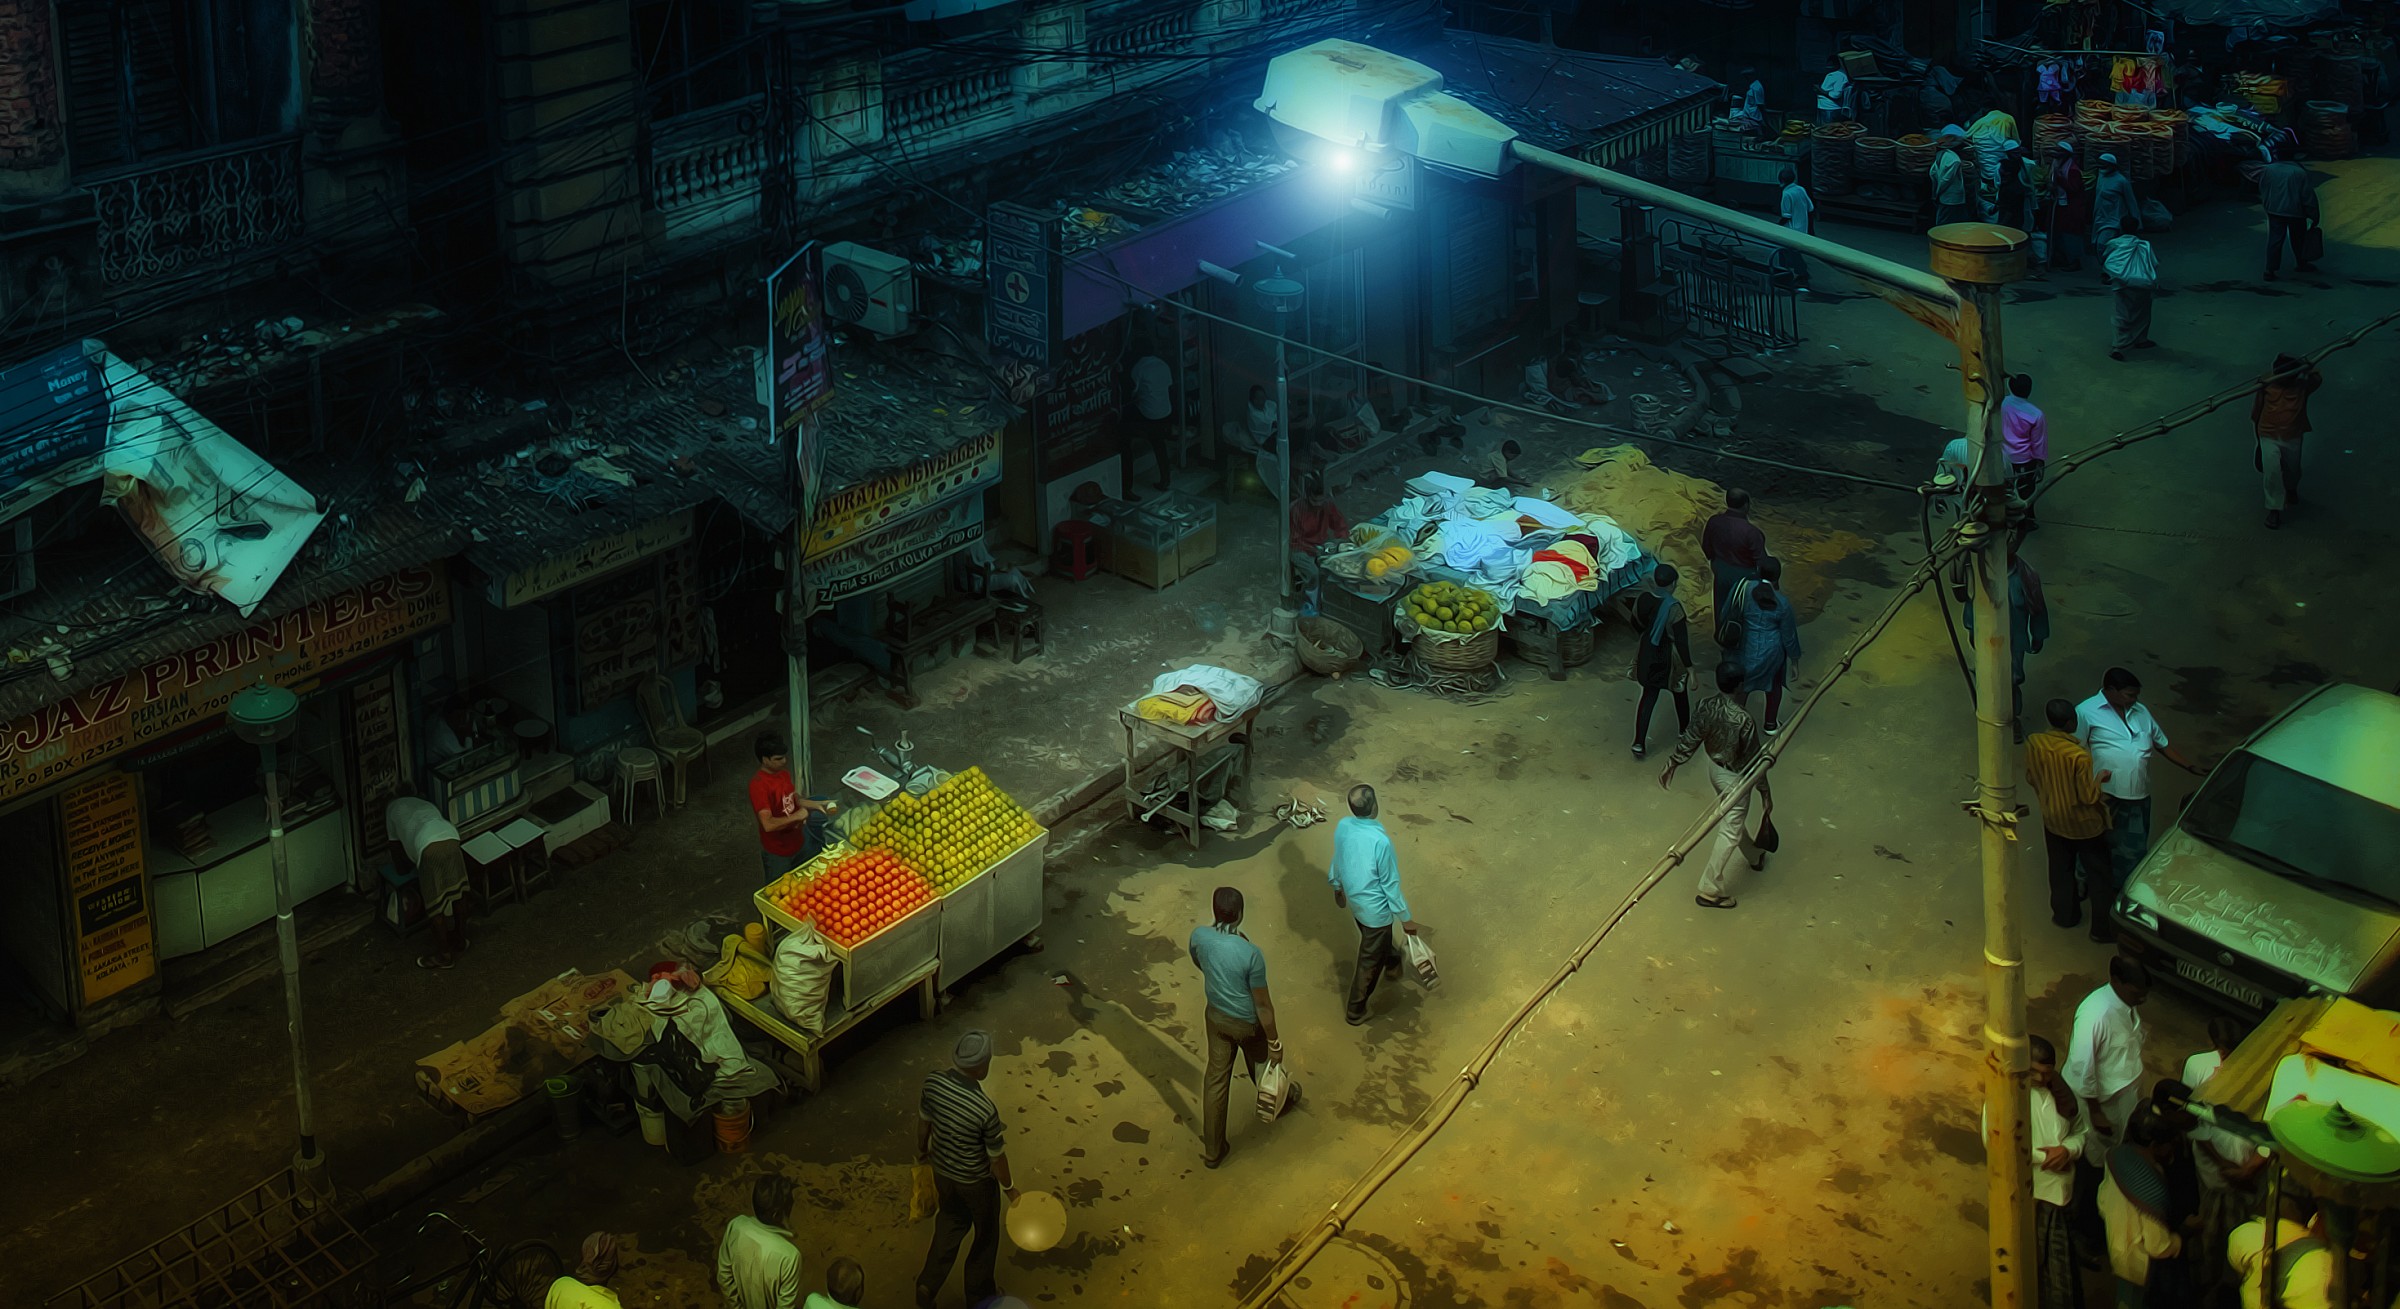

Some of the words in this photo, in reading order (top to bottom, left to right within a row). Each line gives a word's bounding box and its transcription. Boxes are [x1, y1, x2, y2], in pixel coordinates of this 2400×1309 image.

[48, 368, 89, 392] Money
[141, 566, 434, 702] PRINTERS
[26, 739, 68, 769] URDU
[131, 690, 189, 727] PERSIAN
[312, 625, 354, 652] XEROX
[357, 607, 403, 635] OFFSET
[407, 590, 444, 617] DONE
[71, 841, 106, 861] RECEIVE
[108, 828, 136, 845] MONEY
